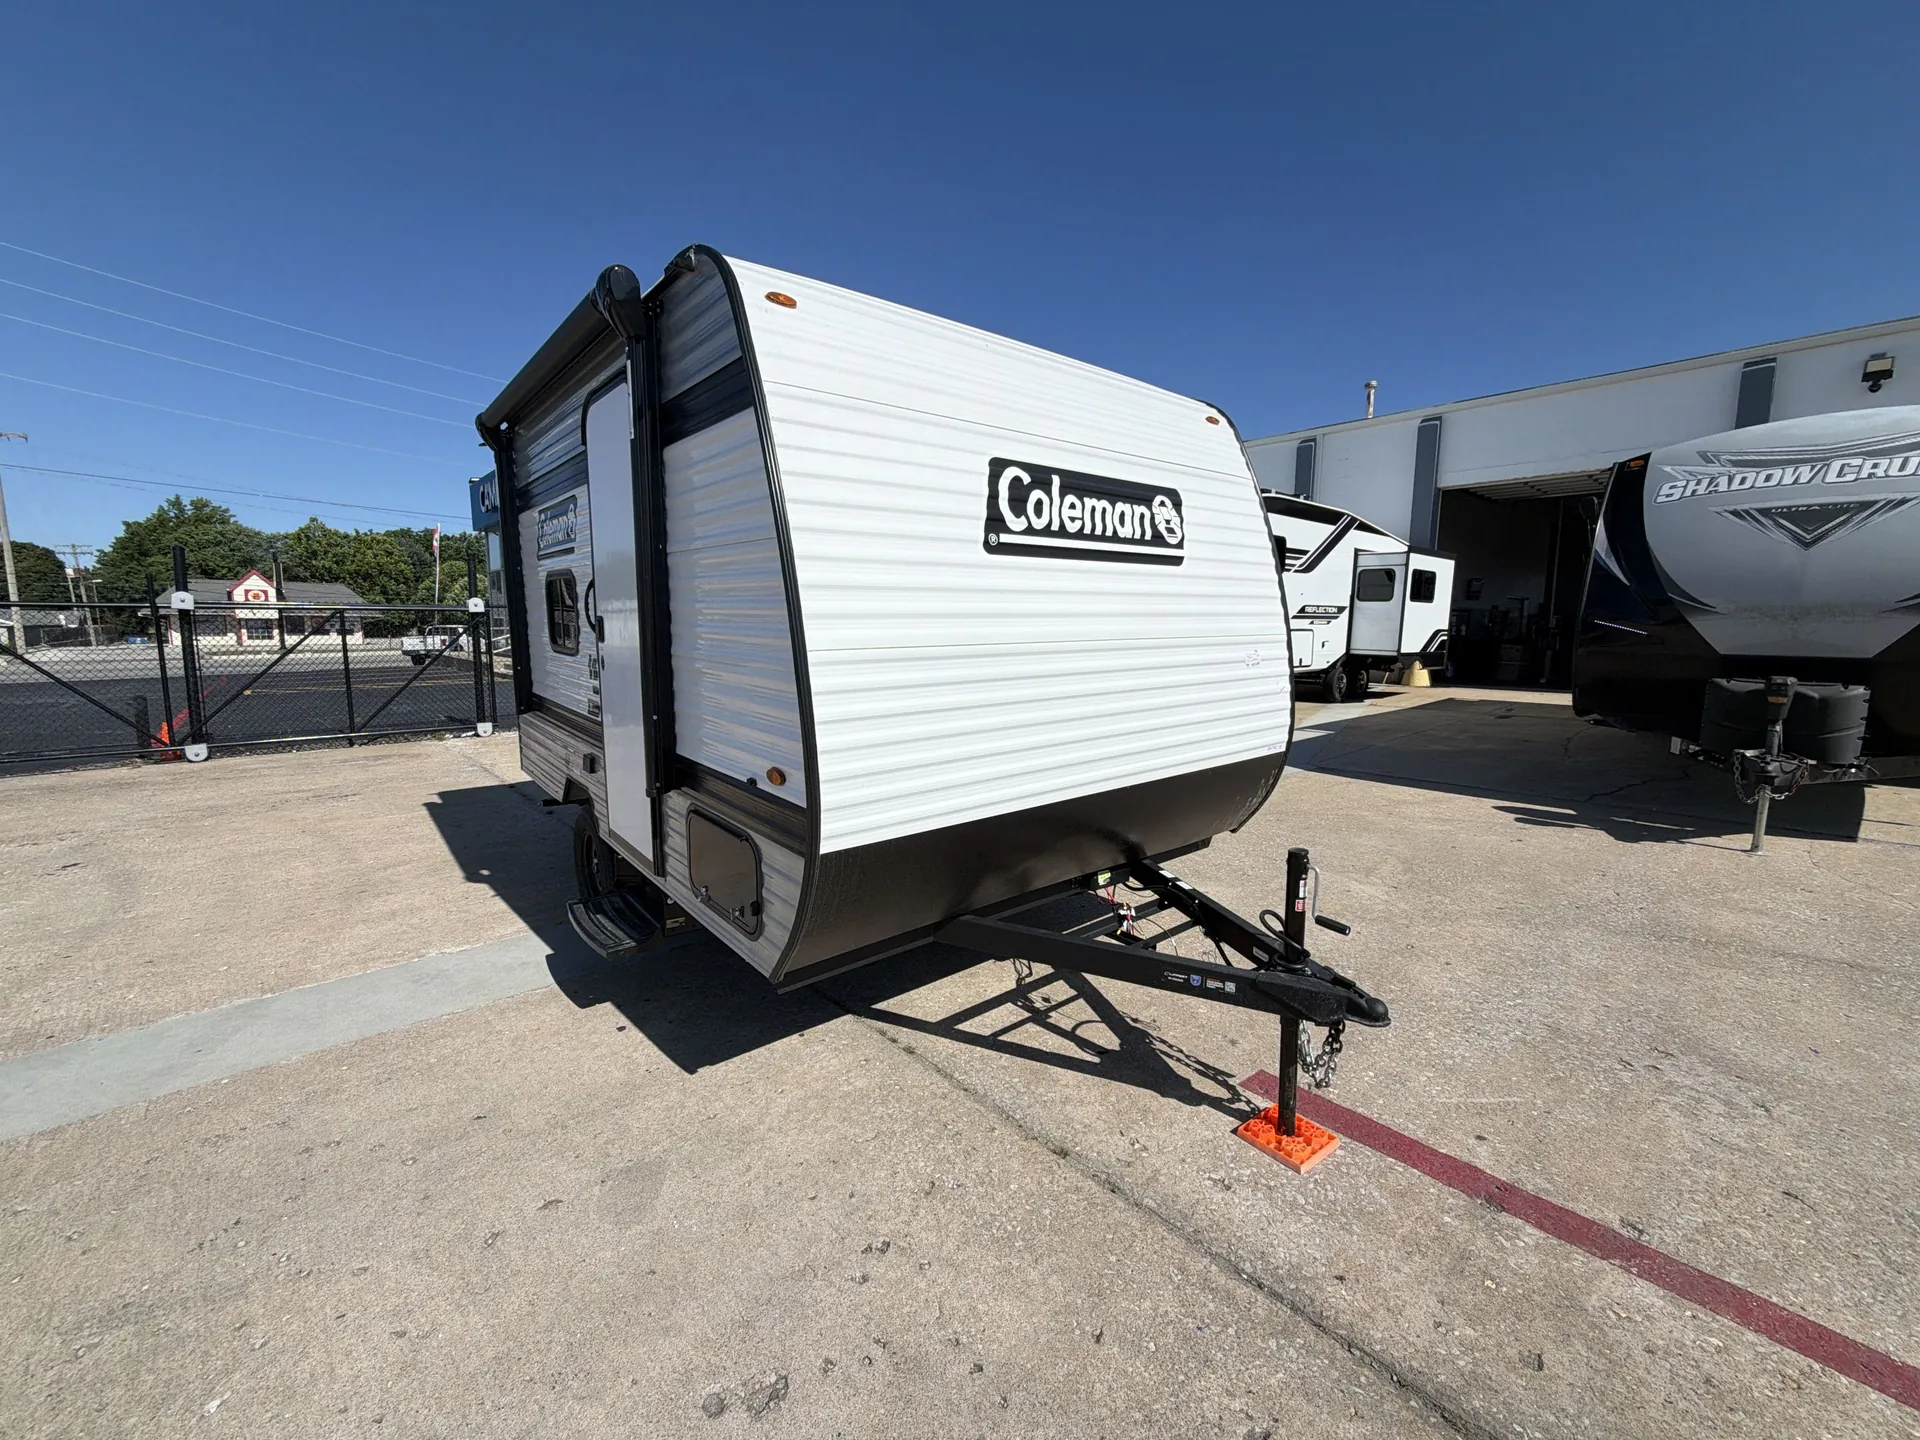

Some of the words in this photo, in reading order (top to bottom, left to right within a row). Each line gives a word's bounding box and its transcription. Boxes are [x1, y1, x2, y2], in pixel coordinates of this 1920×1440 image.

[998, 466, 1152, 540] Coleman
[1654, 463, 1824, 504] SHADOW
[1823, 457, 1920, 483] CRU
